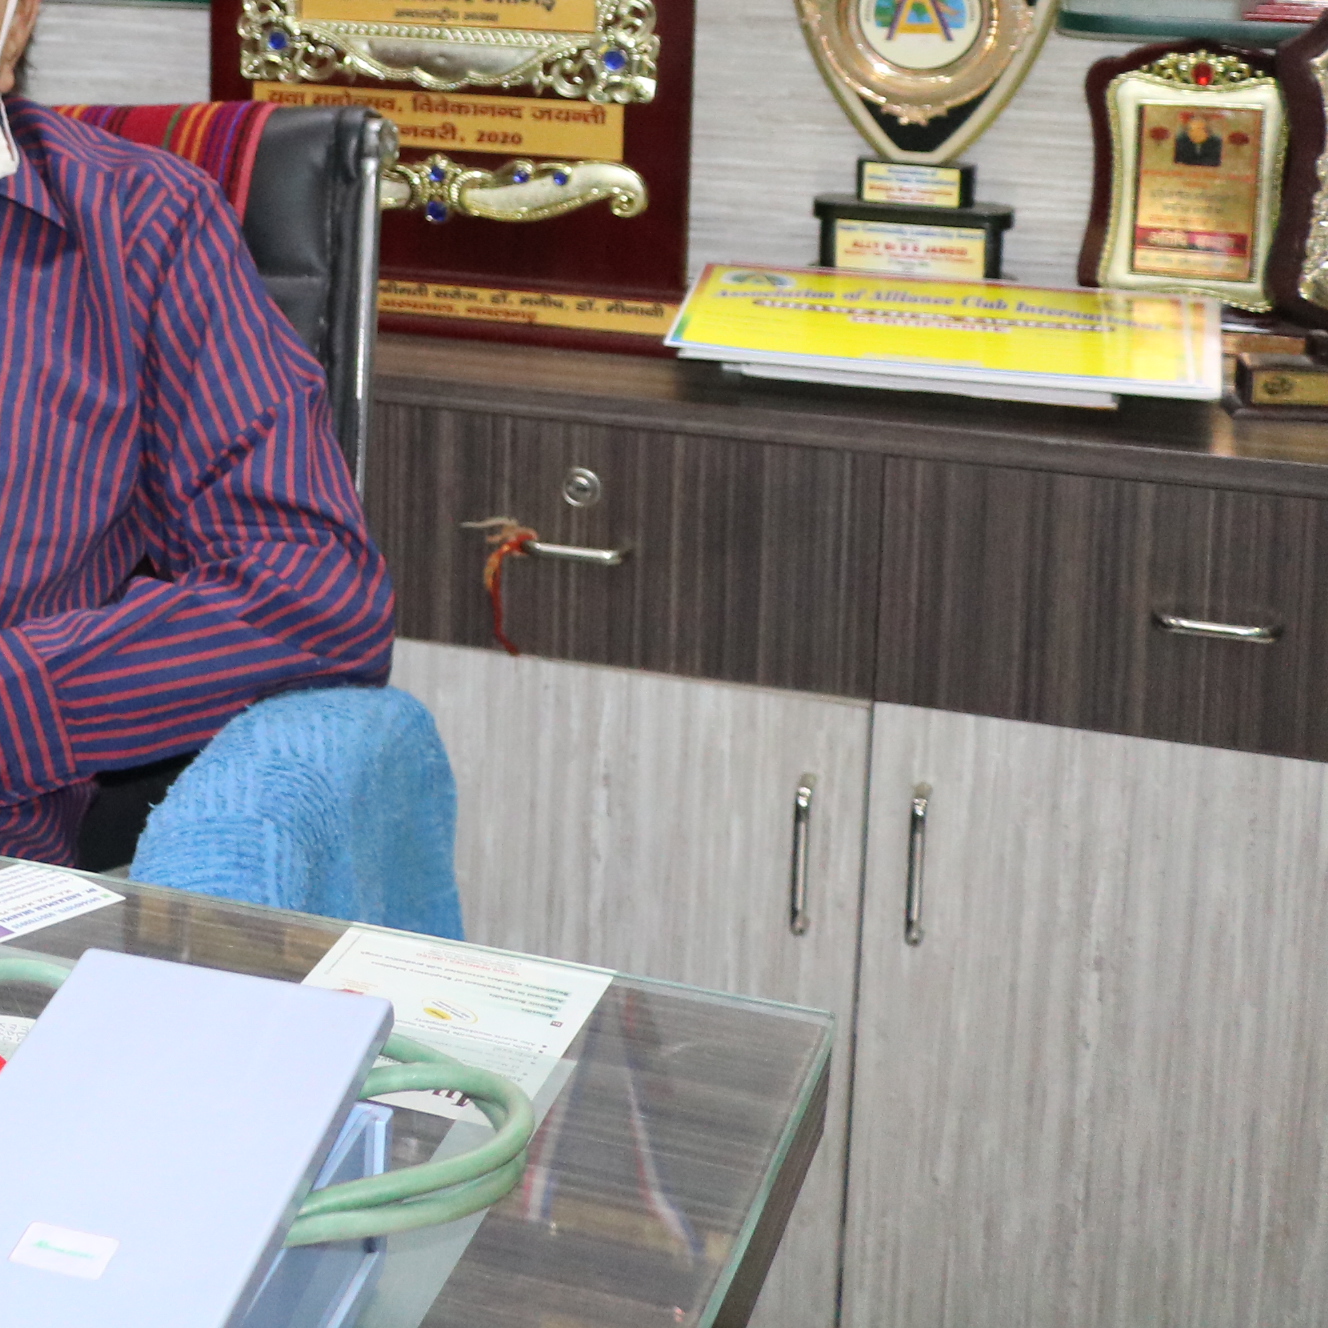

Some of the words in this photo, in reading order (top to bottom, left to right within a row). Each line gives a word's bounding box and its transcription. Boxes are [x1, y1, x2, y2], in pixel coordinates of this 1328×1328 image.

[411, 93, 523, 121] विवेकानन्द
[399, 124, 465, 146] नवरी,
[476, 128, 524, 147] 2020
[842, 289, 865, 302] of
[874, 290, 955, 306] Alliance
